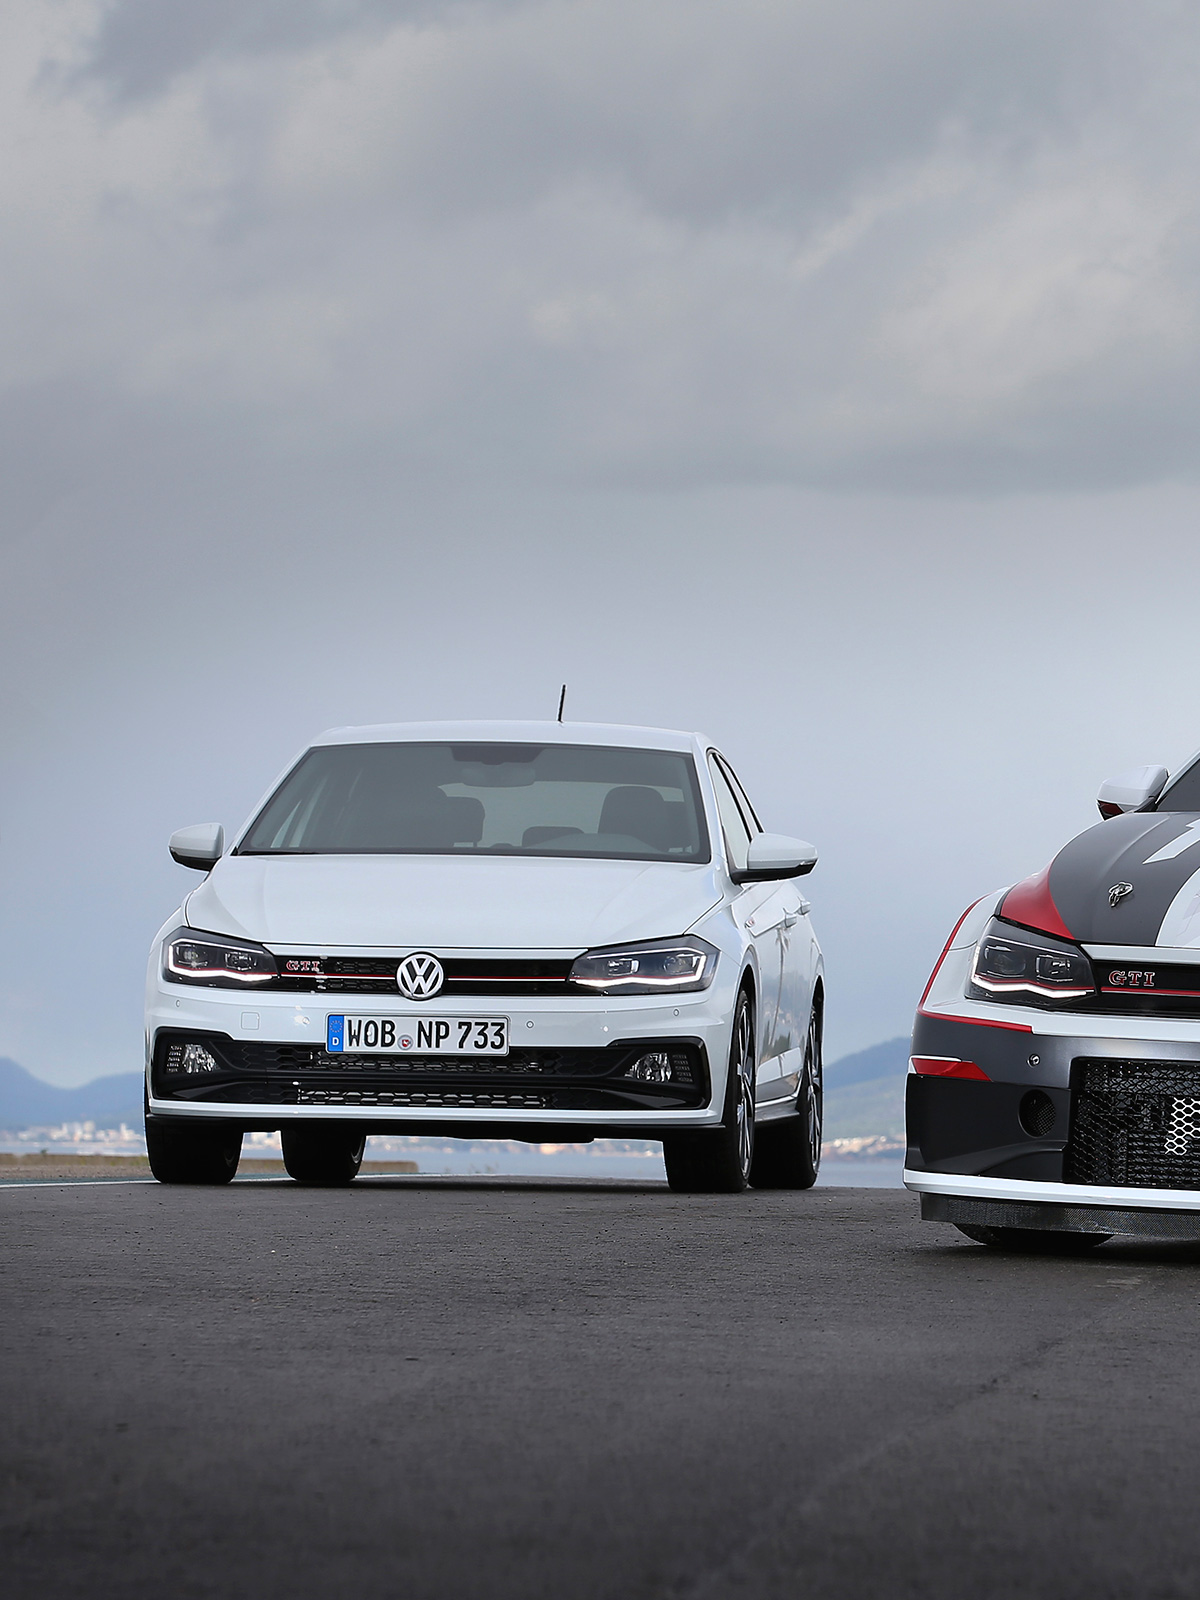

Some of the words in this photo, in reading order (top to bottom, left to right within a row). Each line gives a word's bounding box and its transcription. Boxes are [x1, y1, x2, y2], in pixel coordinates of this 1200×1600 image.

[286, 960, 321, 971] GTI
[398, 954, 443, 999] VW
[1109, 971, 1155, 986] GTI
[332, 1037, 339, 1046] D
[348, 1020, 395, 1047] WOB
[417, 1021, 450, 1048] NP
[457, 1022, 505, 1049] 733
